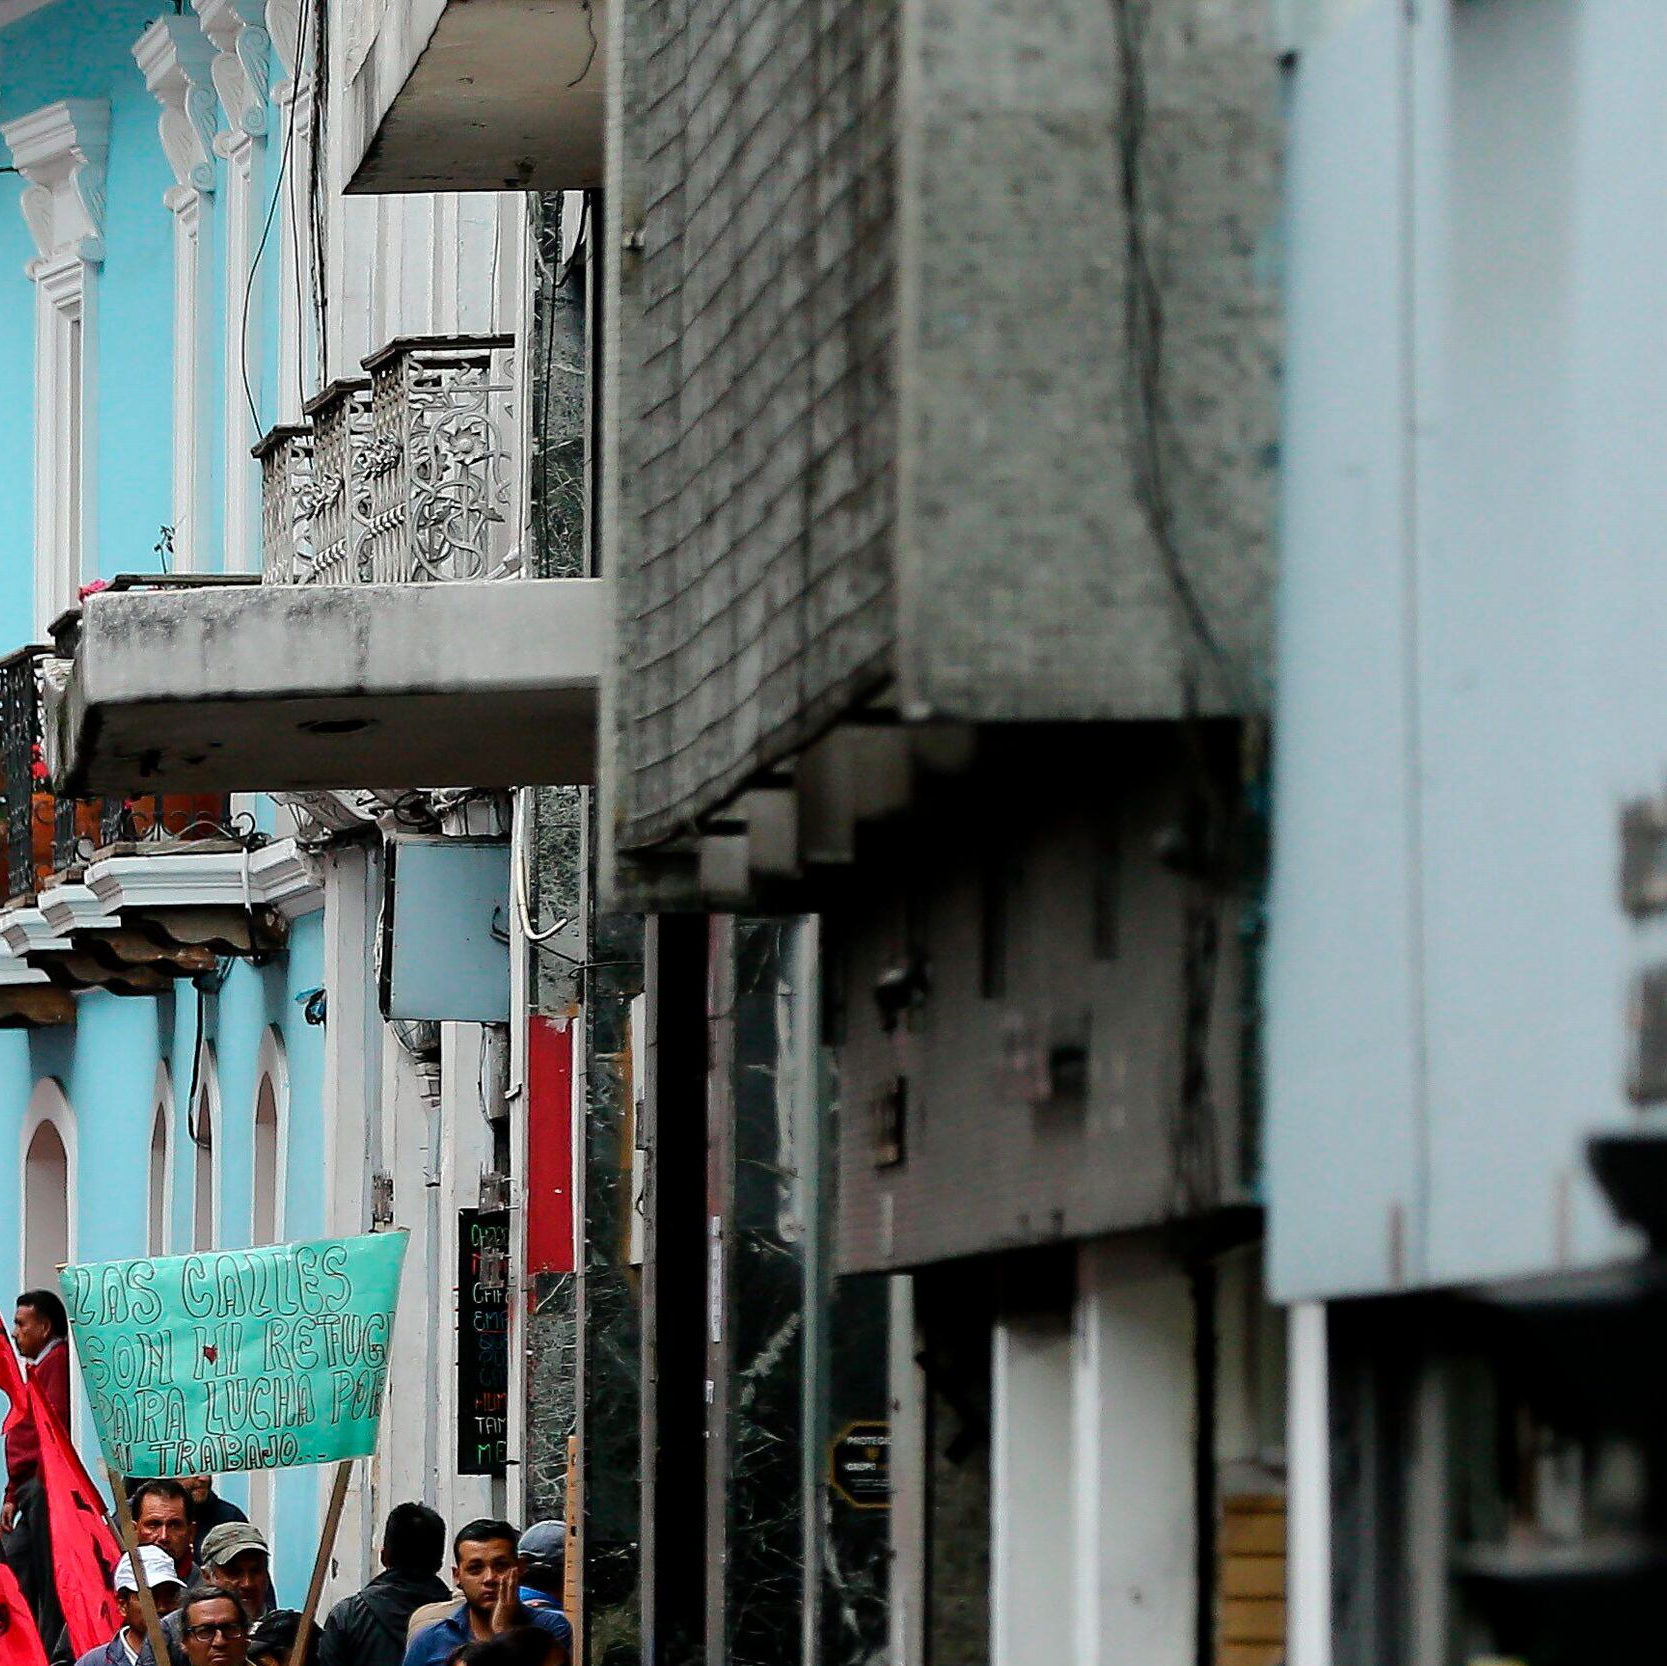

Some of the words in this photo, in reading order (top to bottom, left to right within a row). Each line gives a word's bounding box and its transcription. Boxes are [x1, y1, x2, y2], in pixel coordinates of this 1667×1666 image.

[73, 1260, 162, 1326] LAS
[182, 1245, 353, 1319] CALLES
[83, 1328, 175, 1390] SON
[193, 1322, 244, 1381] MI
[95, 1387, 188, 1444] PARA
[203, 1374, 316, 1435] LUCHA
